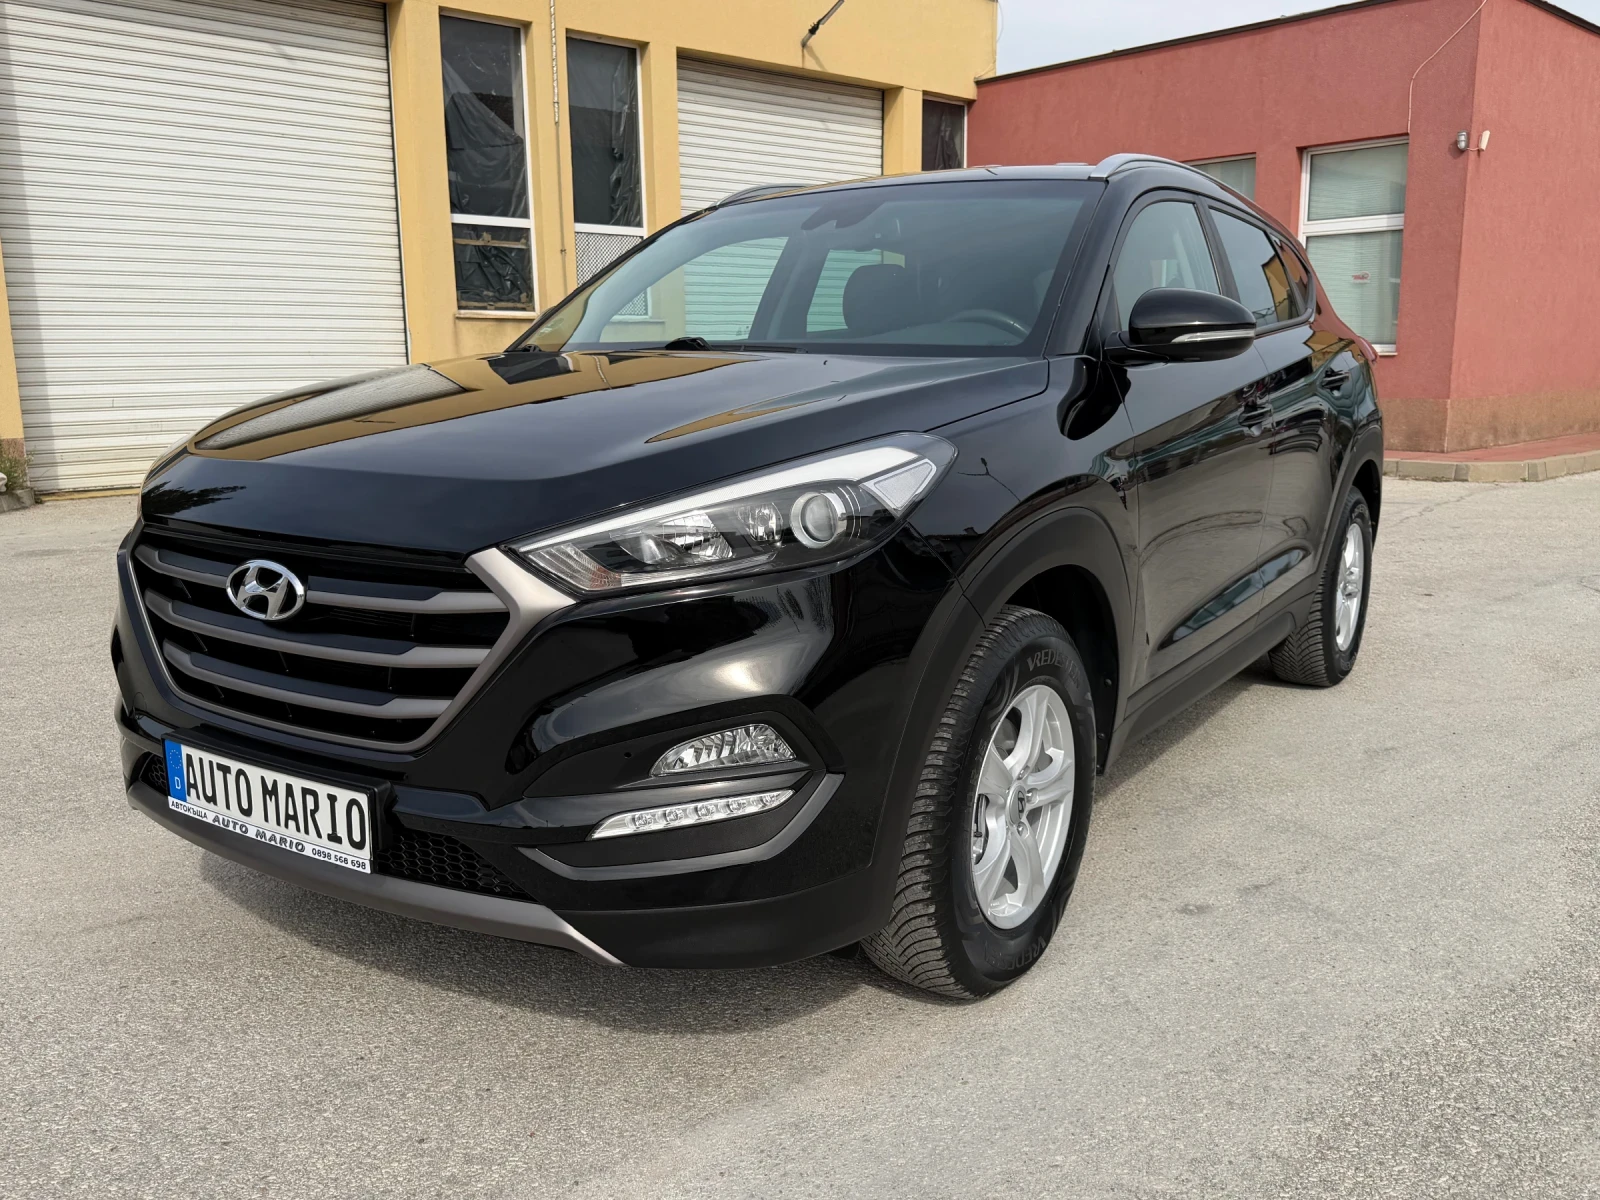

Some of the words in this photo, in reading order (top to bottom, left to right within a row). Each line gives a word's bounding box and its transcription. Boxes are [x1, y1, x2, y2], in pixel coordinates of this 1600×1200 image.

[174, 776, 182, 790] D
[185, 752, 253, 818] AUTO
[260, 775, 367, 851] MARIO
[171, 800, 208, 819] АВТОКЪЩА
[212, 815, 249, 835] AUTO
[254, 829, 306, 853] MARIO
[311, 847, 332, 860] 0898
[334, 854, 349, 865] 568
[350, 859, 367, 870] 698
